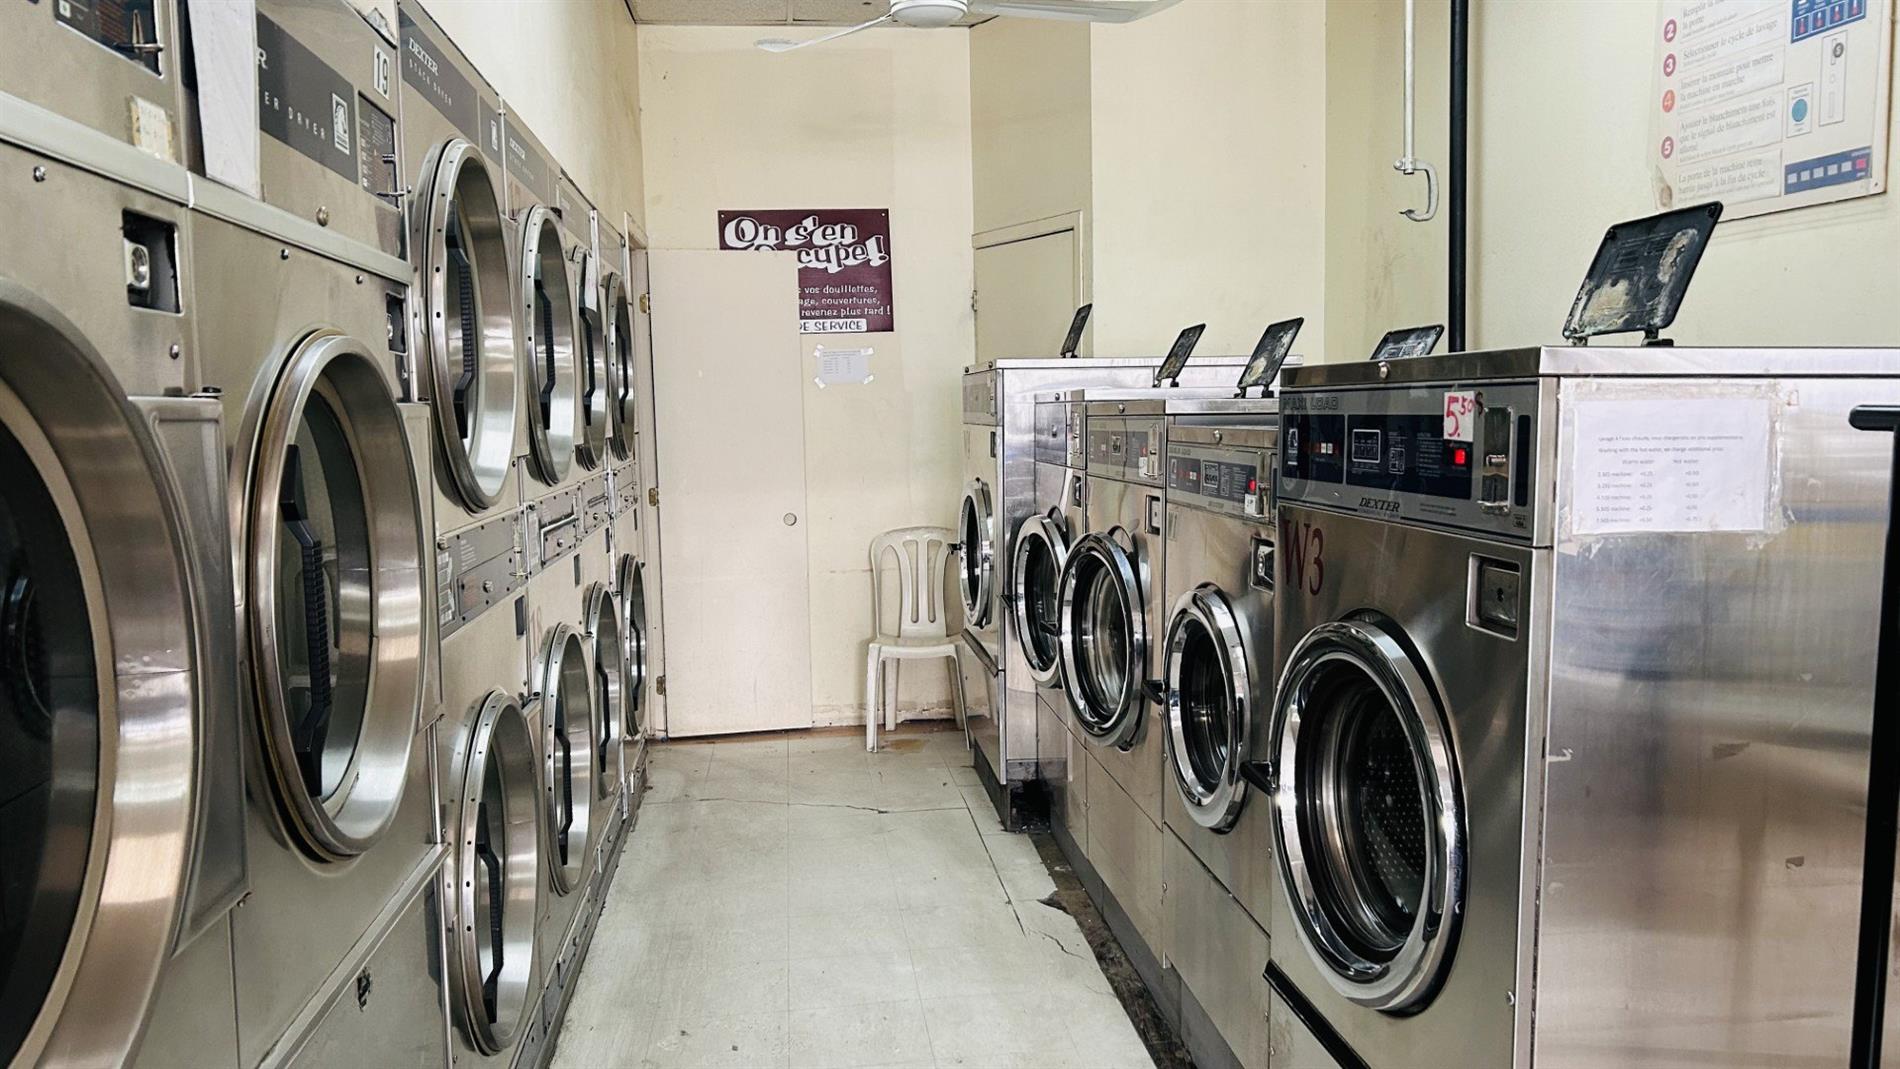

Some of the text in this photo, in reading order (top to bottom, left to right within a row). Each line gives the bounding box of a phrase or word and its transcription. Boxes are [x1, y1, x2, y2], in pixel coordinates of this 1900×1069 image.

[1727, 31, 1745, 47] cycle
[1745, 27, 1753, 36] de
[1755, 19, 1778, 32] lavage
[409, 37, 438, 76] DEXTER
[1736, 61, 1751, 75] pour
[1752, 53, 1774, 65] mettre
[376, 50, 388, 96] 19
[1687, 84, 1712, 99] machine
[1721, 74, 1745, 90] marche
[1720, 159, 1746, 174] machine
[724, 215, 858, 248] On s'en
[804, 286, 820, 294] vos
[801, 308, 838, 317] revenez
[840, 307, 862, 317] plus
[864, 305, 884, 315] tard
[821, 297, 880, 306] couvertures,
[814, 320, 863, 331] SERVICE
[1359, 497, 1400, 513] DEXTER
[1282, 518, 1325, 597] W3
